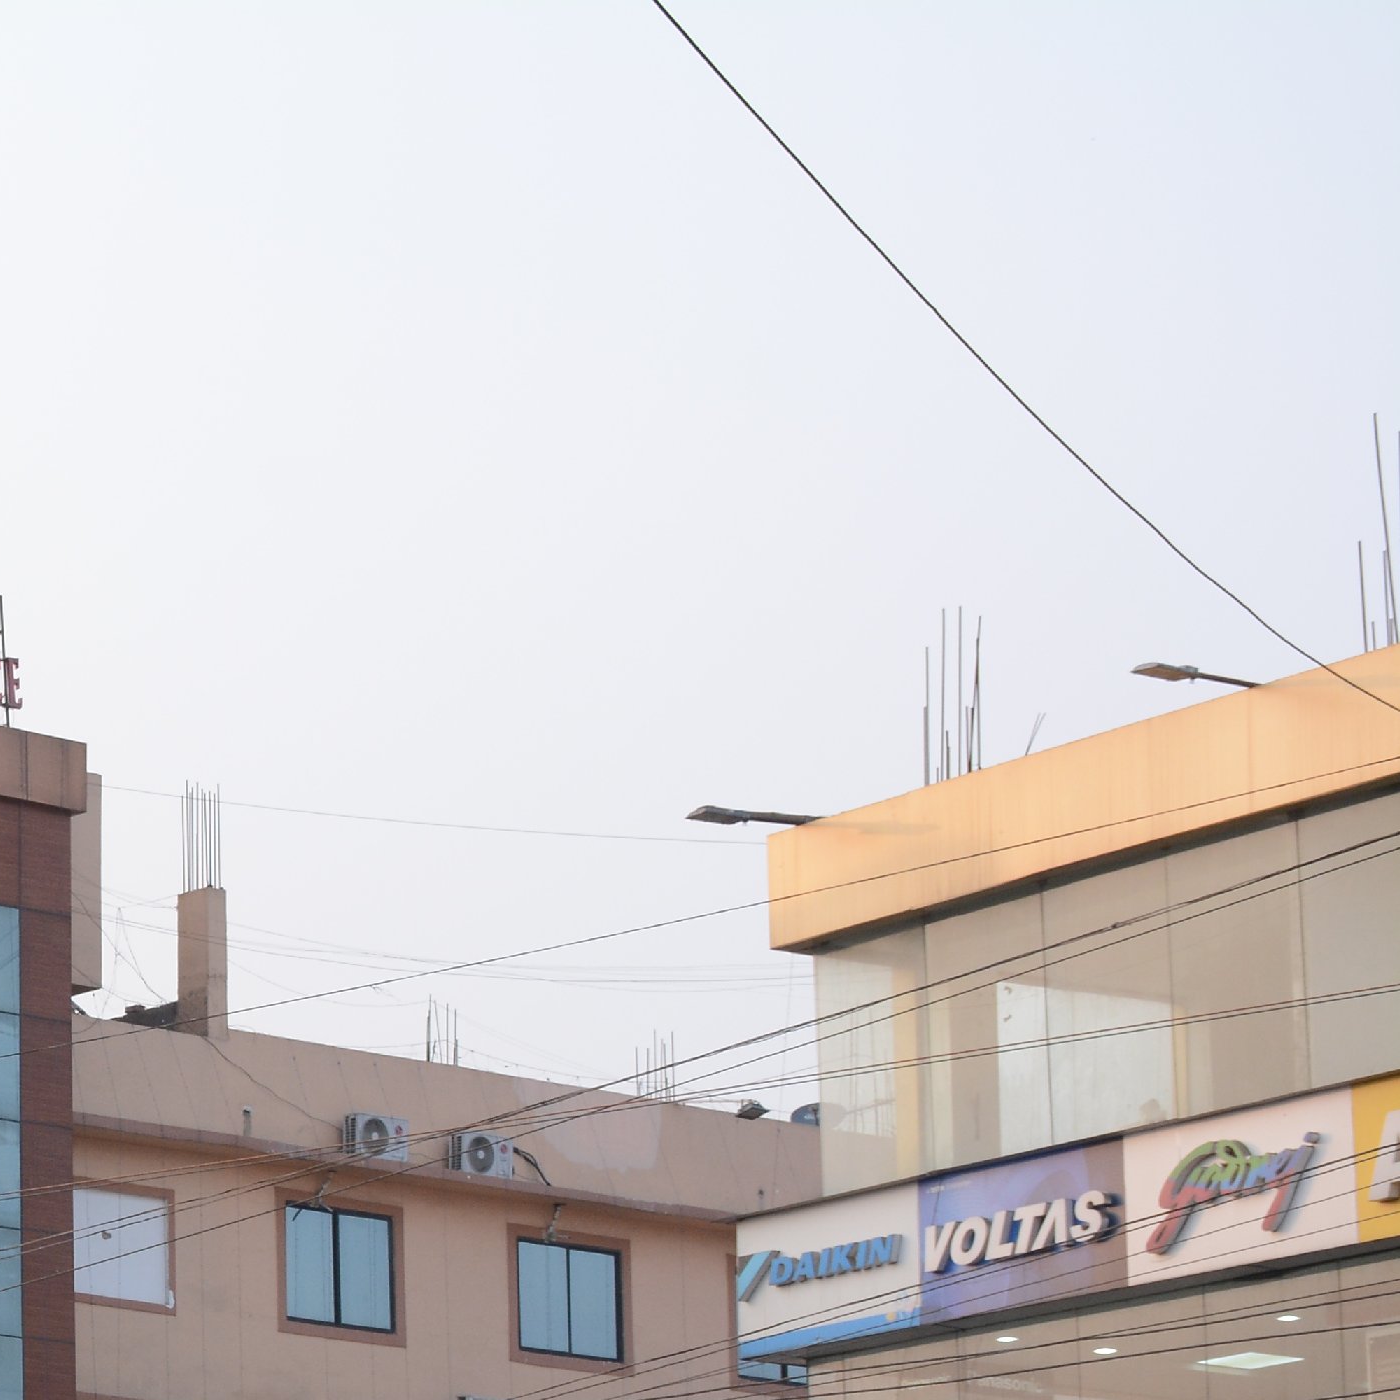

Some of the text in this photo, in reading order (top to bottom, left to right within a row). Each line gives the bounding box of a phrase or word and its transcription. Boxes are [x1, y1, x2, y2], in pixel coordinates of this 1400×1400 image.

[923, 1188, 1113, 1275] VOLTAS
[1146, 1131, 1321, 1255] Godrej
[768, 1233, 903, 1287] DAIKIN
